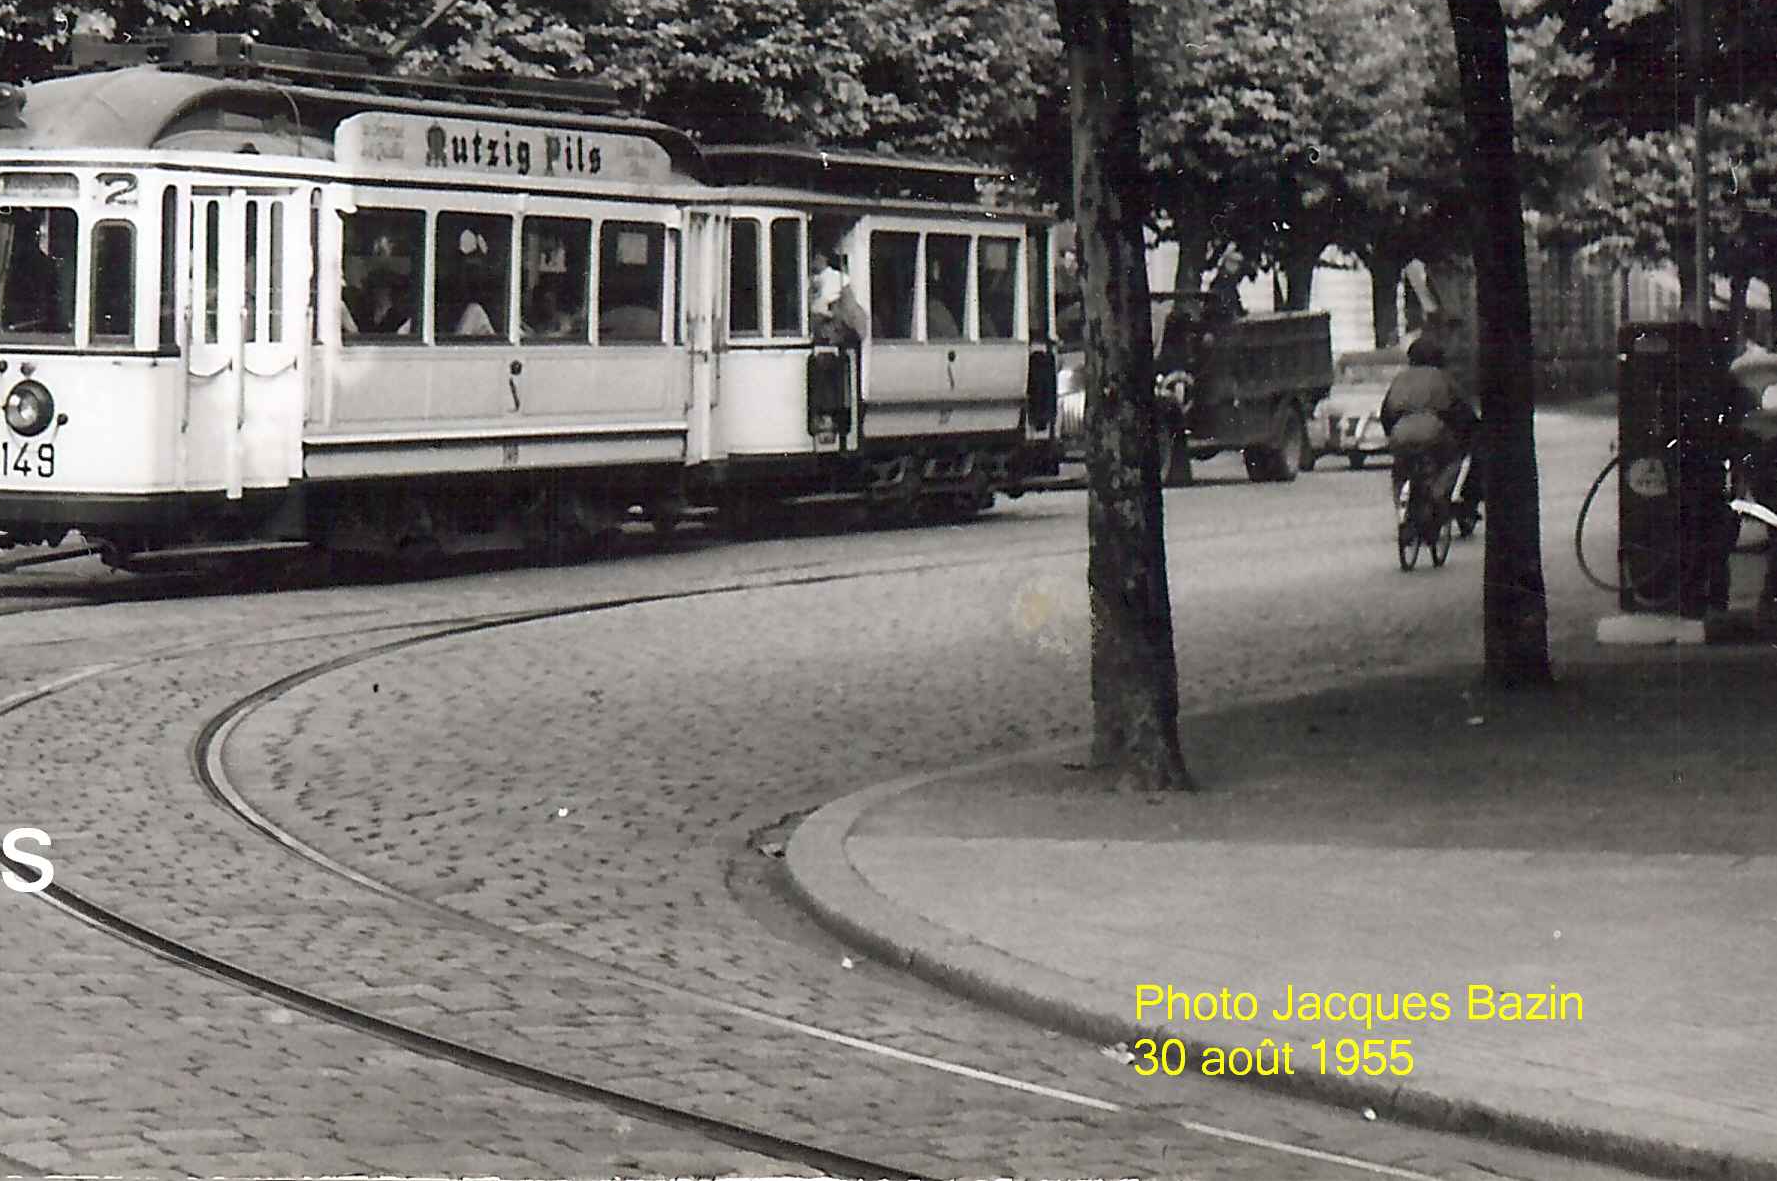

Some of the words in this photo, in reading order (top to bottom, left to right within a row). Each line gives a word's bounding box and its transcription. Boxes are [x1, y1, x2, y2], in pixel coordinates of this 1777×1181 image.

[544, 132, 601, 176] Pils
[96, 172, 138, 205] 2
[2, 442, 54, 478] 149
